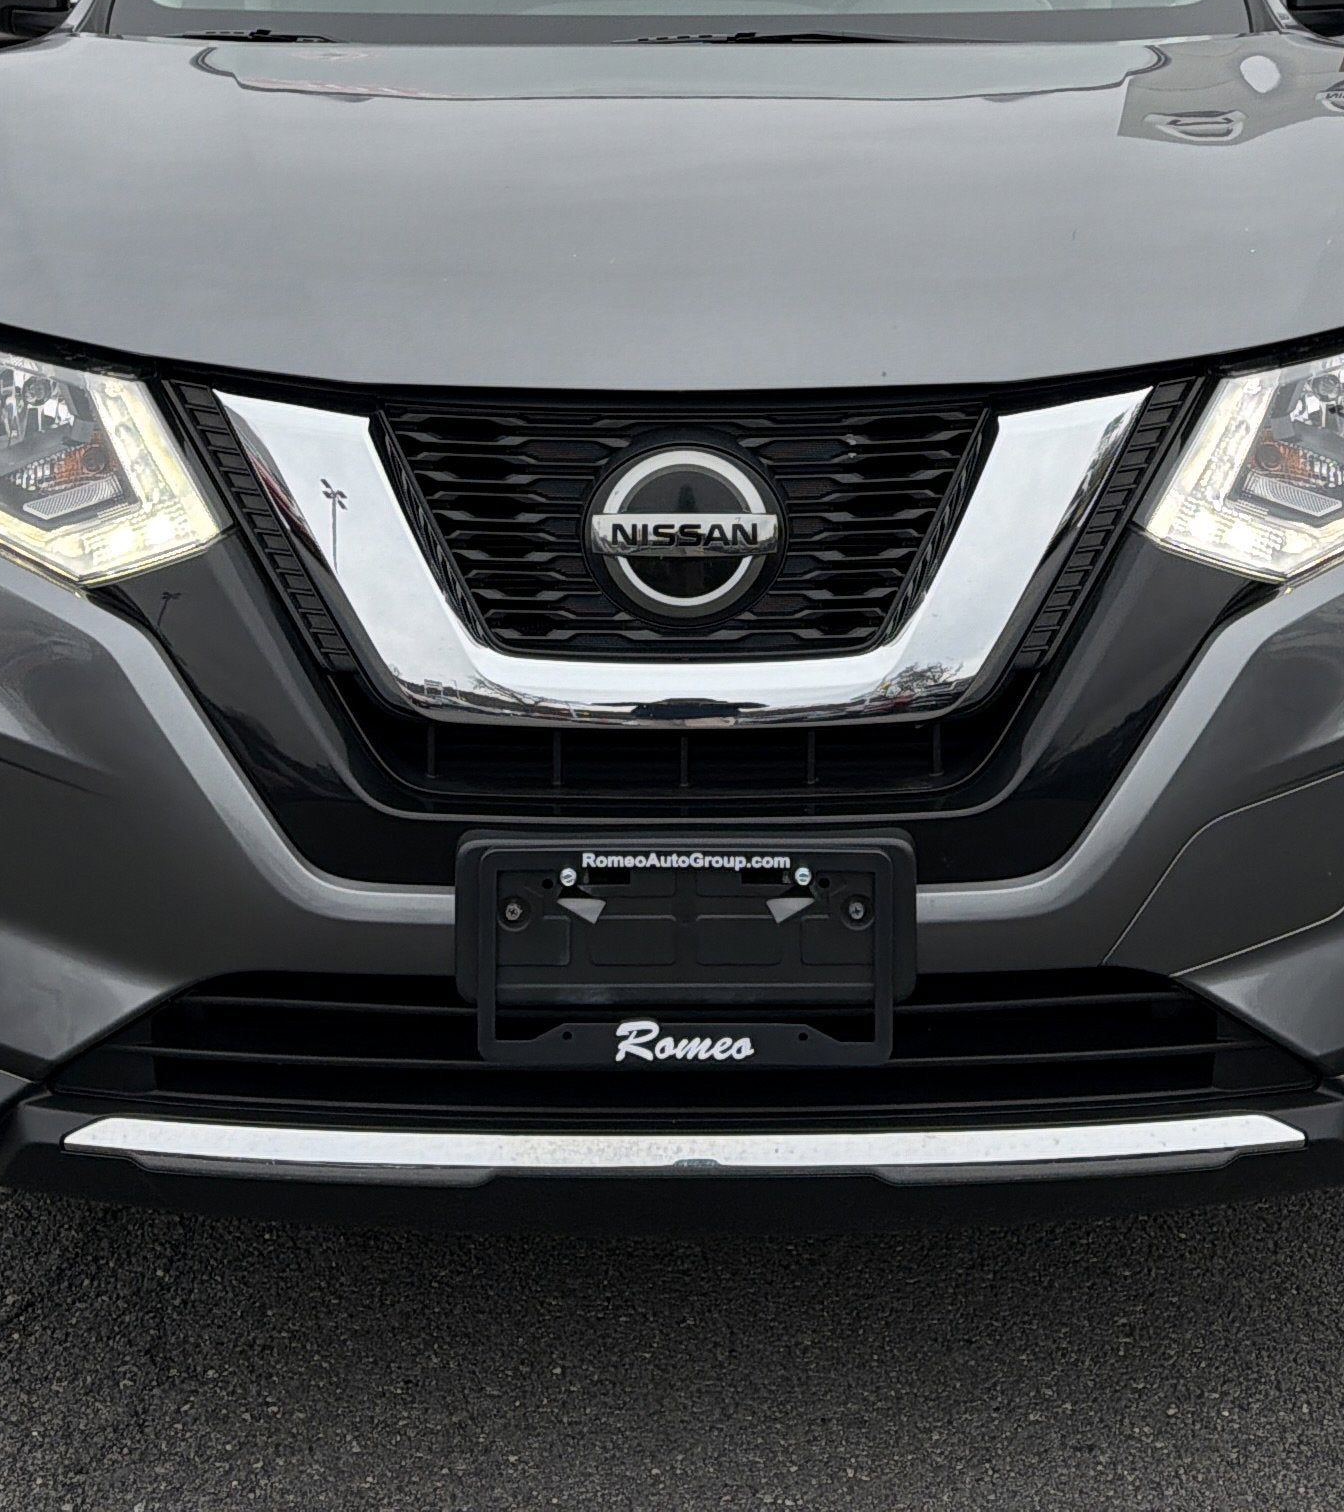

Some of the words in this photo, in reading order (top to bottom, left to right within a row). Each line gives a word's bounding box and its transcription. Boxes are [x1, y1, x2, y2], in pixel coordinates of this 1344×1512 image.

[611, 523, 758, 547] NISSAN
[582, 852, 791, 871] RomeoAutoGroup.com
[615, 1020, 754, 1062] Romeo
